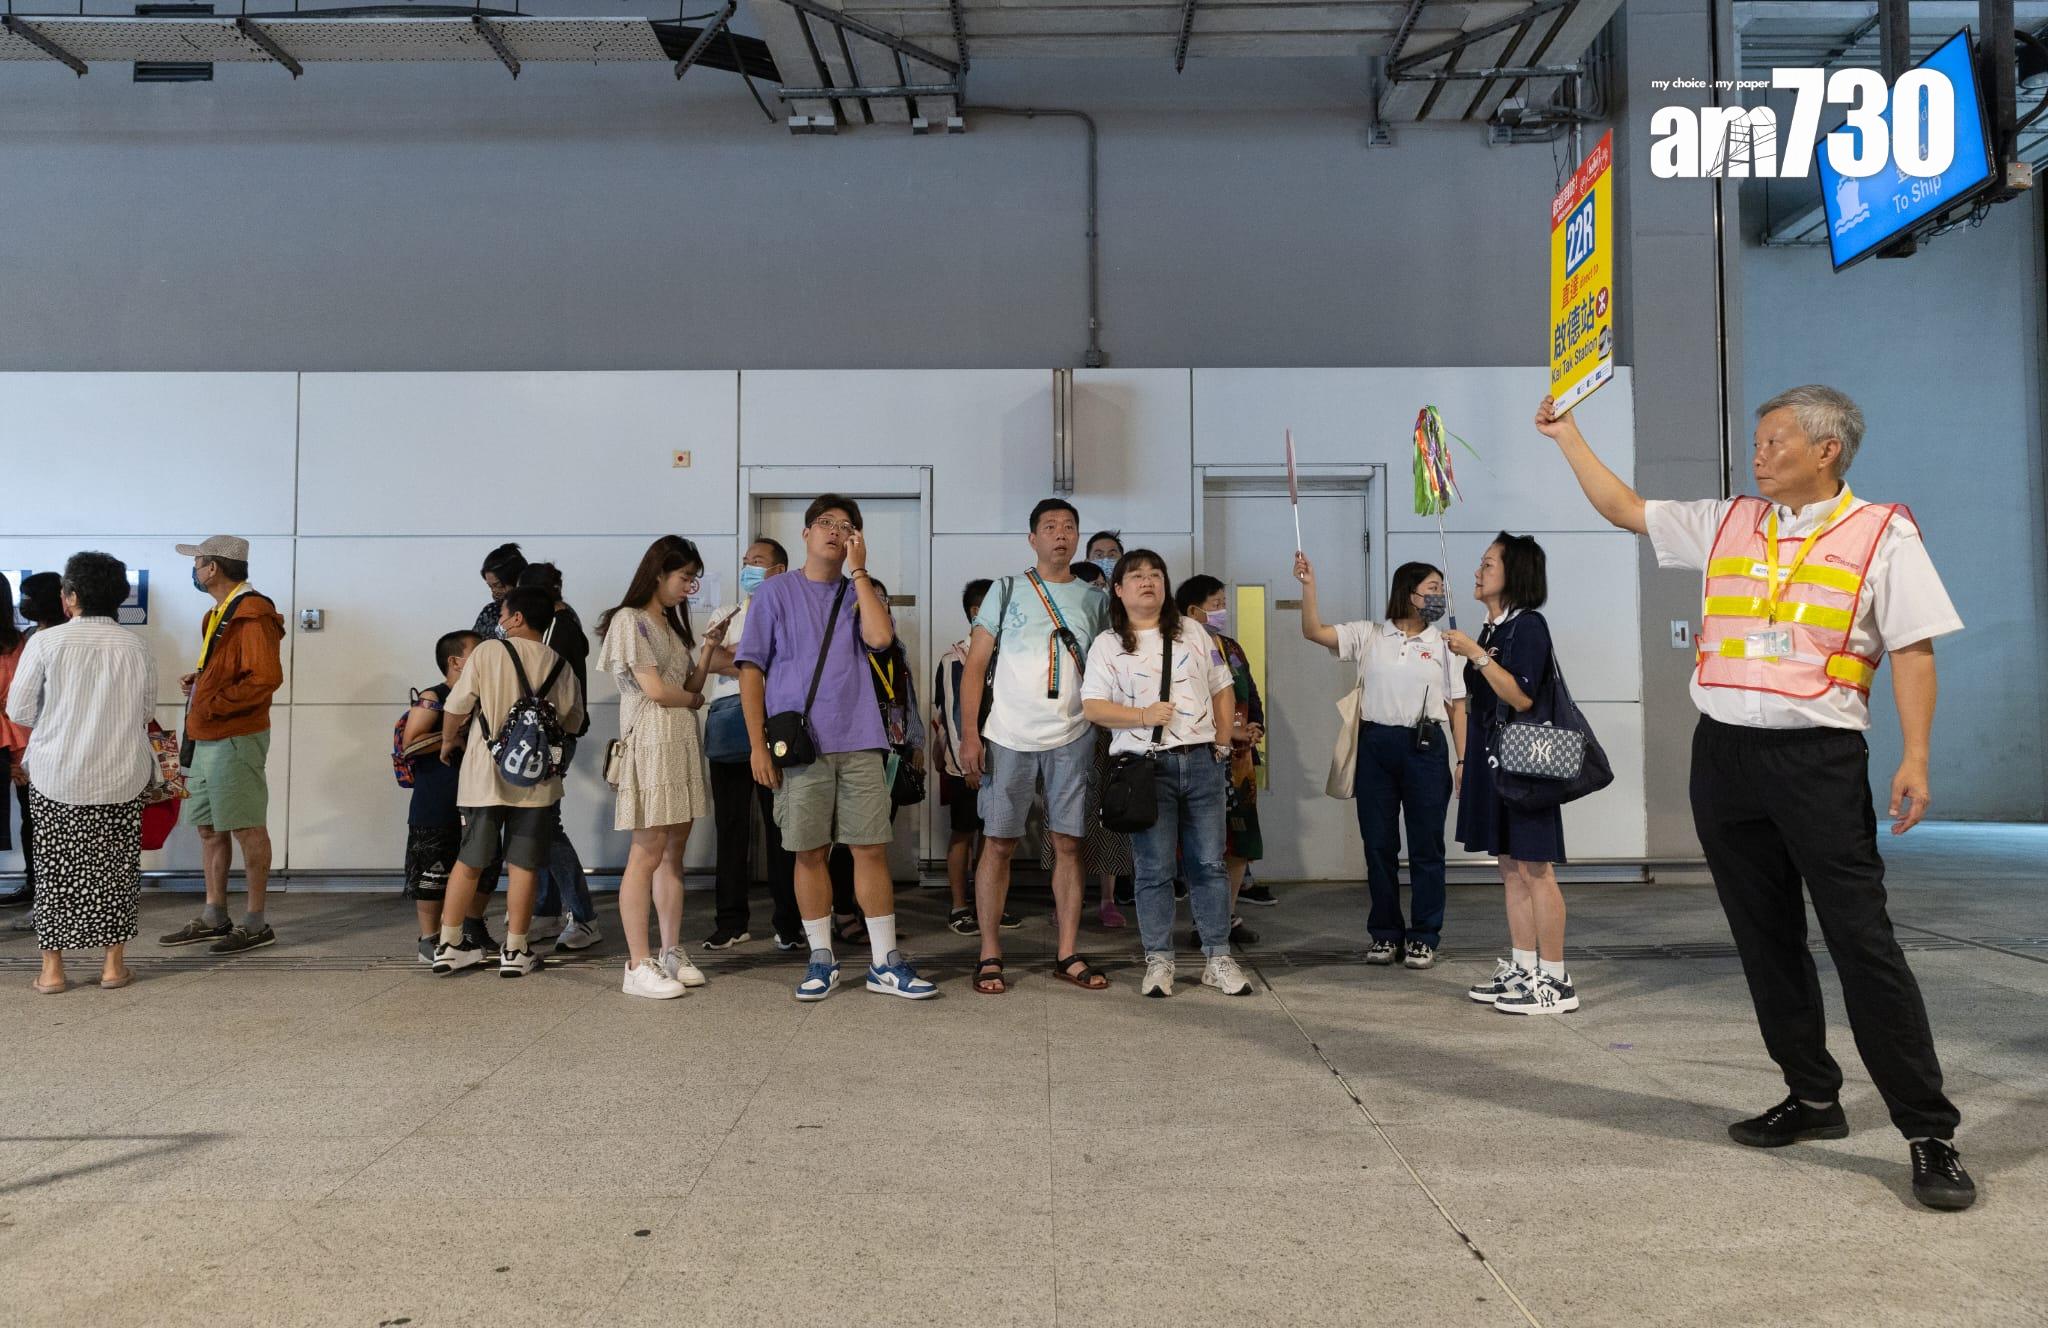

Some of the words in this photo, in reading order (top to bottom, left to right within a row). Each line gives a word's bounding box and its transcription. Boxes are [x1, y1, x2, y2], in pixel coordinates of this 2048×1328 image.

[1892, 194, 1909, 213] To
[1911, 175, 1942, 203] Ship
[1567, 201, 1593, 273] 22R
[1562, 274, 1579, 310] 直達
[1551, 363, 1562, 385] Kai
[1562, 353, 1574, 376] Tak
[1574, 336, 1598, 366] Station
